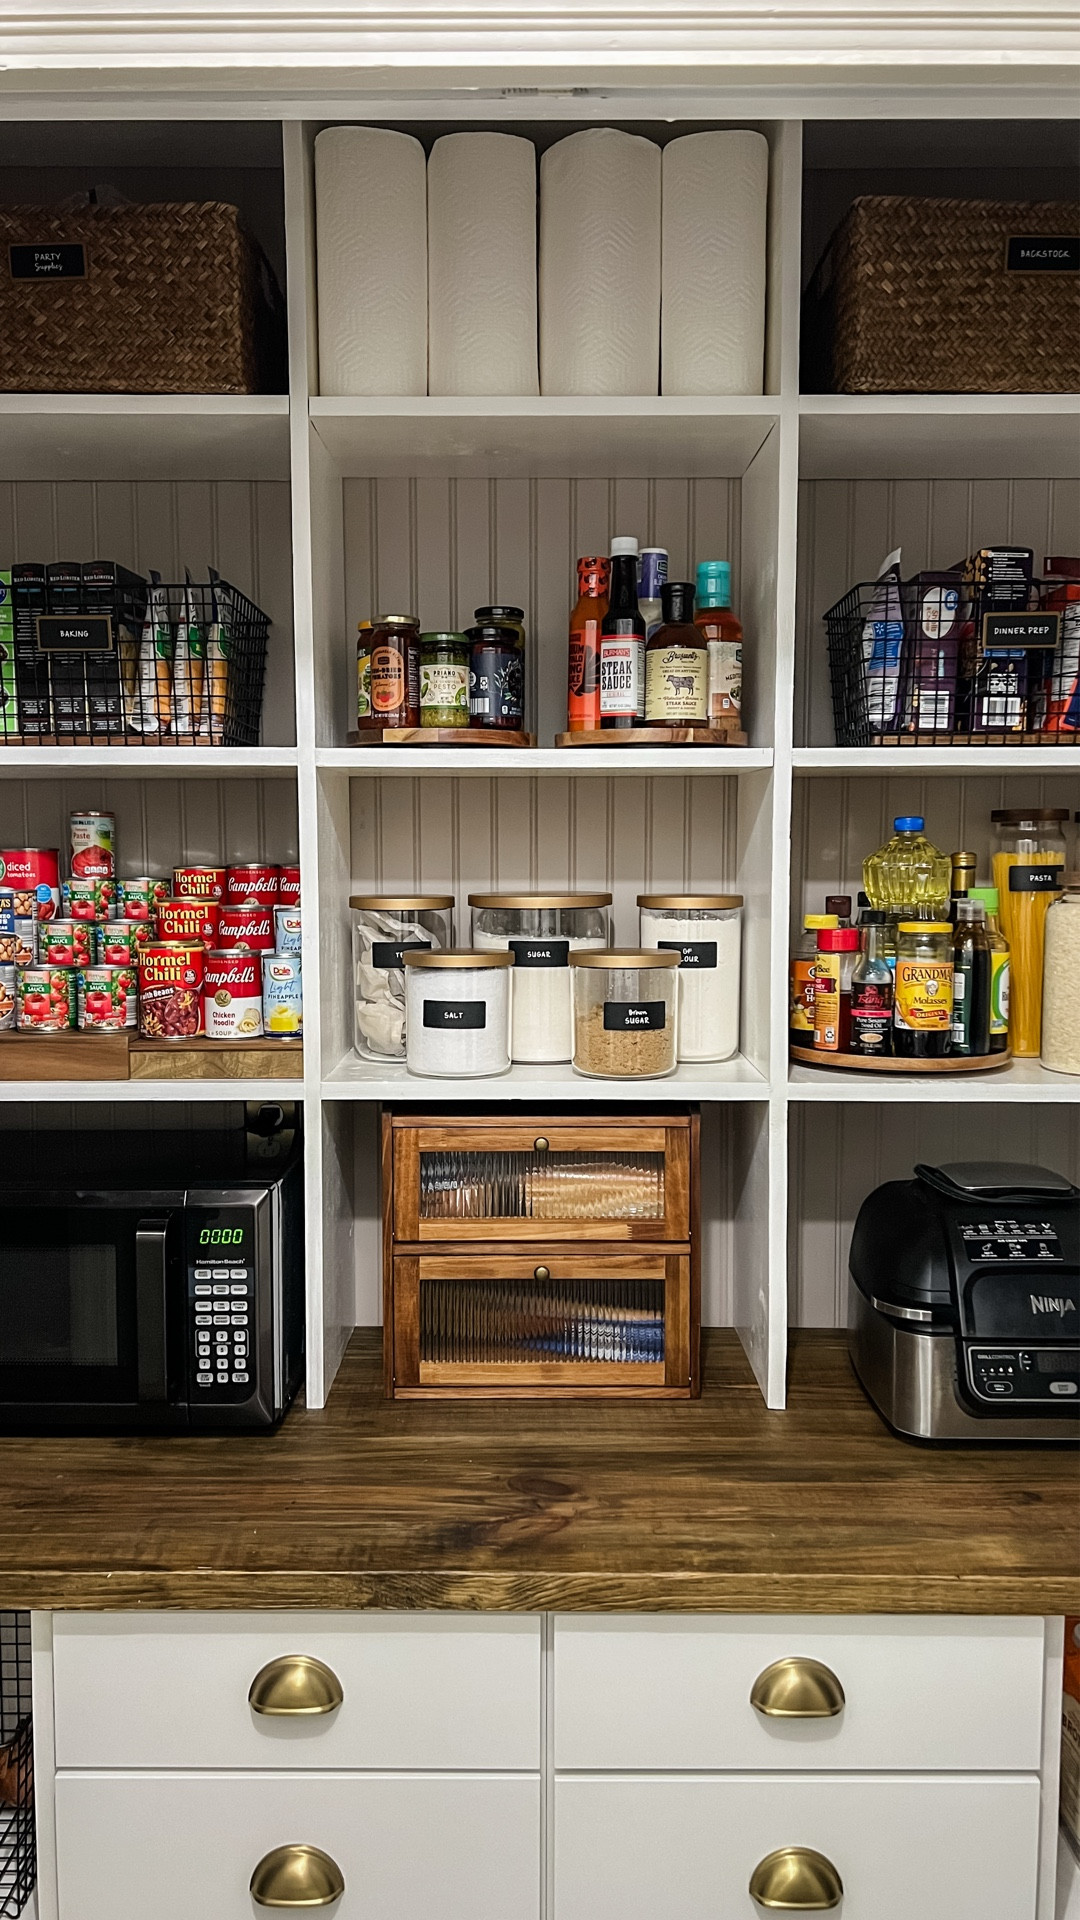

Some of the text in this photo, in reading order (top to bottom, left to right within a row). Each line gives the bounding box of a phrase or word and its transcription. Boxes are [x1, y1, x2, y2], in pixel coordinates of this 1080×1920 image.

[34, 252, 61, 261] PARTY
[1020, 249, 1071, 258] BACKSTOCK
[34, 262, 63, 272] Supplies
[60, 630, 89, 638] BAKING
[994, 626, 1050, 635] DINNER PREP
[601, 660, 632, 676] STEAK
[602, 675, 631, 690] SAUCE
[7, 861, 31, 871] diced
[175, 871, 217, 883] Hormel
[180, 883, 210, 894] Chili
[228, 876, 278, 895] Campbell's
[158, 905, 209, 919] Hormel
[163, 921, 200, 933] Chili
[218, 919, 270, 939] Campbell's
[139, 951, 191, 966] Hormel
[144, 966, 181, 981] Chili
[273, 967, 291, 975] Dole
[153, 987, 175, 997] Beans
[269, 981, 298, 994] Light
[624, 1016, 650, 1024] SUGAR
[199, 1228, 243, 1244] 0000
[1030, 1294, 1076, 1318] NINJA
